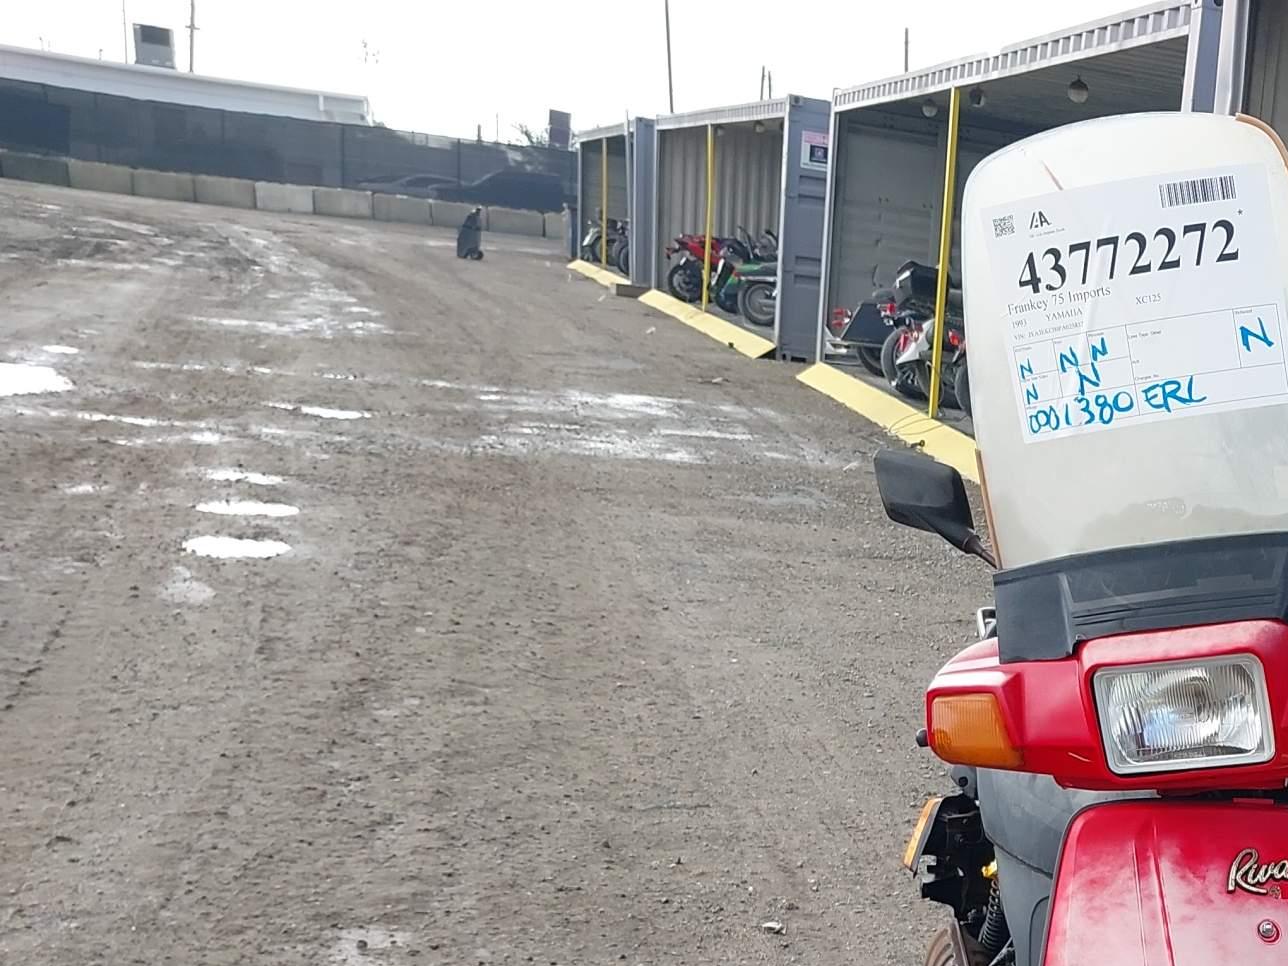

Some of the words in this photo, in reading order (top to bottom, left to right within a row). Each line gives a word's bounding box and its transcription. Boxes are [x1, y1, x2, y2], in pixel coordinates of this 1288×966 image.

[1018, 219, 1239, 294] 43772272
[1007, 299, 1049, 316] Frankey
[1052, 293, 1065, 306] 75
[1068, 286, 1111, 303] Imports
[1135, 293, 1161, 305] XC125
[1045, 307, 1083, 322] YAMAHA
[1239, 316, 1275, 353] N
[1059, 346, 1079, 374] N
[1091, 337, 1108, 362] N
[1020, 358, 1034, 380] N
[1078, 362, 1101, 396] N
[1026, 383, 1039, 405] N
